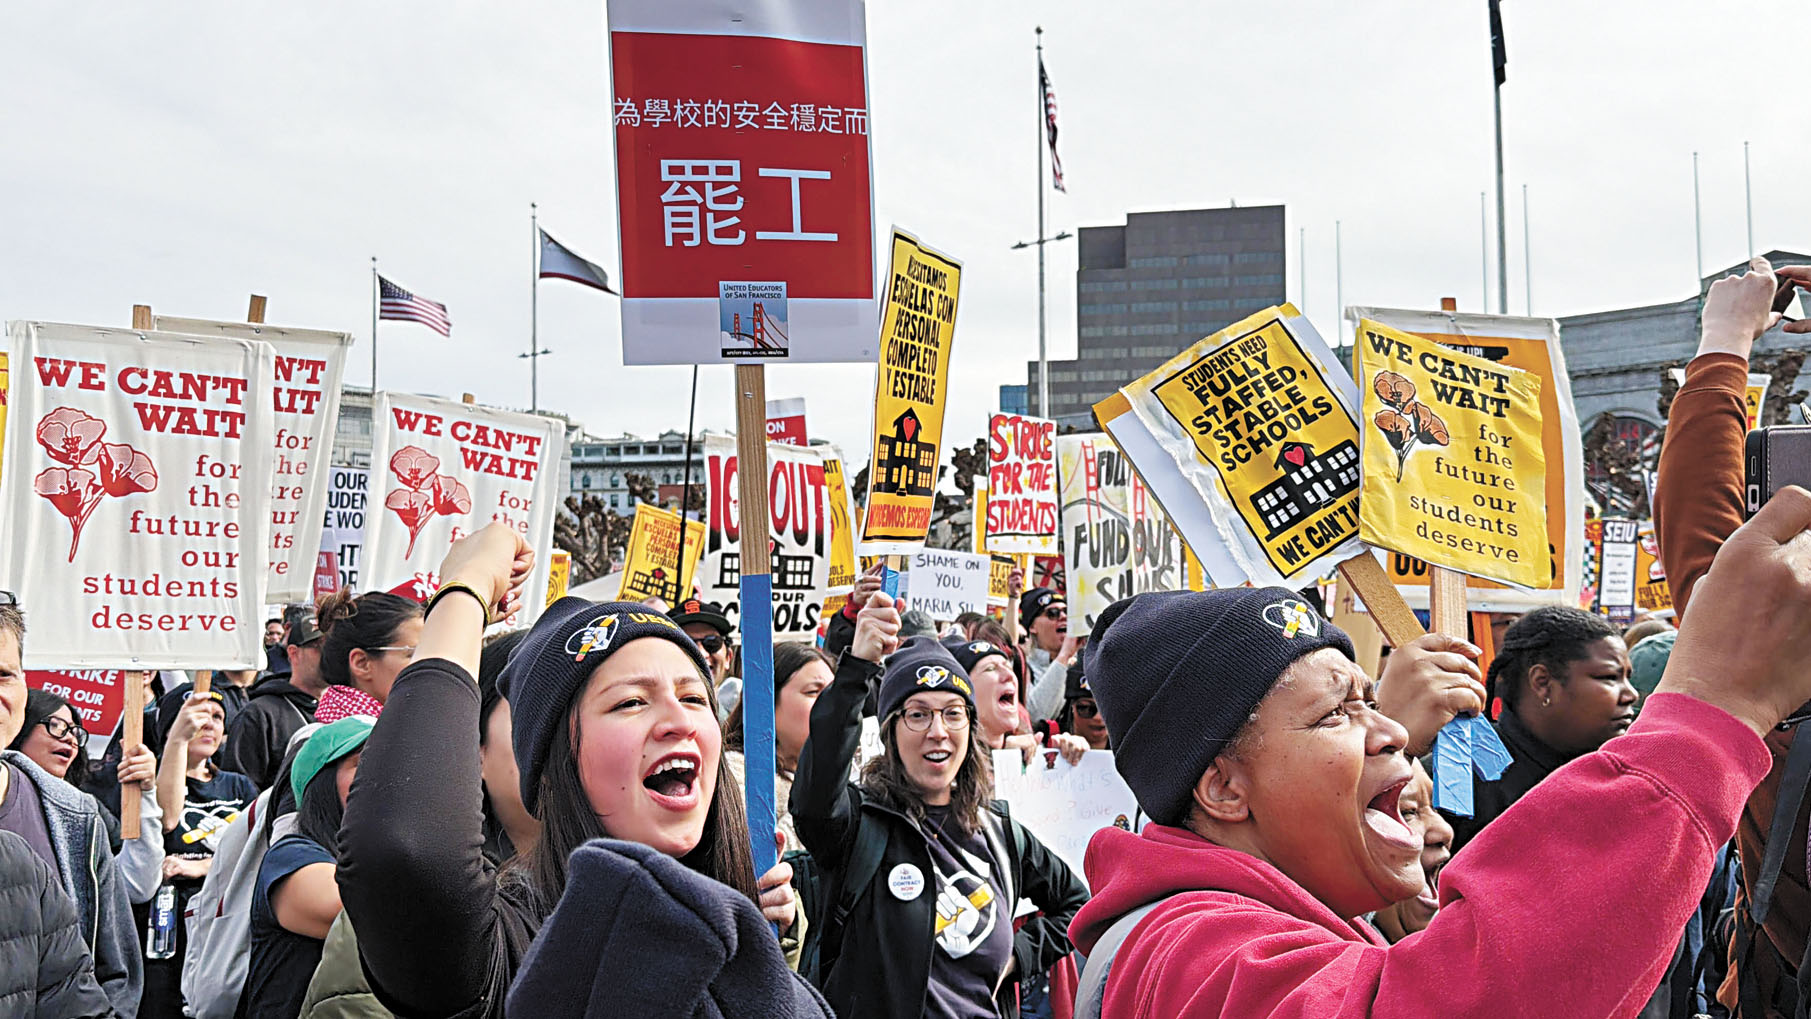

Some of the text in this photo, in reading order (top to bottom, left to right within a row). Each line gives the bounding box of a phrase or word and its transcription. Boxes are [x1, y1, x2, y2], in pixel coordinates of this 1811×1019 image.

[613, 97, 868, 135] 為學校的安全穩定而
[660, 159, 838, 247] 罷工
[748, 284, 783, 292] EDUCATORS
[936, 294, 954, 324] CON
[893, 307, 941, 349] PERSONAL
[886, 337, 937, 377] COMPLETO
[1181, 335, 1268, 391] STUDENTS NEED
[1366, 331, 1510, 394] WE CAN'T
[34, 356, 248, 405] WE CAN'T
[892, 370, 936, 406] ESTABLE
[1193, 351, 1271, 407] FULLY
[1191, 365, 1308, 435] STAFFED,
[1430, 379, 1511, 418] WAIT
[133, 402, 246, 439] WAIT
[392, 407, 541, 457] WE CAN'T
[1212, 385, 1307, 449] STABLE
[1220, 395, 1333, 472] SCHOOLS
[274, 428, 313, 450] for
[990, 414, 1053, 463] STRIKE
[1478, 424, 1513, 449] for
[195, 454, 242, 480] for
[276, 455, 307, 476] he
[460, 447, 538, 482] WAIT
[1434, 457, 1515, 491] future
[1474, 445, 1513, 470] the
[335, 472, 368, 491] OUR
[990, 461, 1053, 495] FOR THE
[188, 484, 241, 509] the
[498, 490, 532, 512] for
[1472, 493, 1517, 514] our
[129, 510, 240, 538] future
[987, 499, 1056, 533] STUDENTS
[1410, 495, 1518, 537] students
[1604, 521, 1636, 542] SEIU
[646, 543, 679, 561] COMPLET
[650, 534, 680, 551] PERSONA
[1073, 517, 1175, 570] FUND OUR
[1276, 534, 1310, 566] WE
[1304, 504, 1357, 550] CAN'T
[1416, 521, 1519, 563] deserve
[181, 549, 240, 569] our
[915, 554, 959, 568] SHAME
[965, 560, 979, 570] ON
[83, 573, 238, 598] students
[91, 605, 237, 632] deserve
[912, 598, 953, 614] MARIA
[73, 689, 105, 706] OUR
